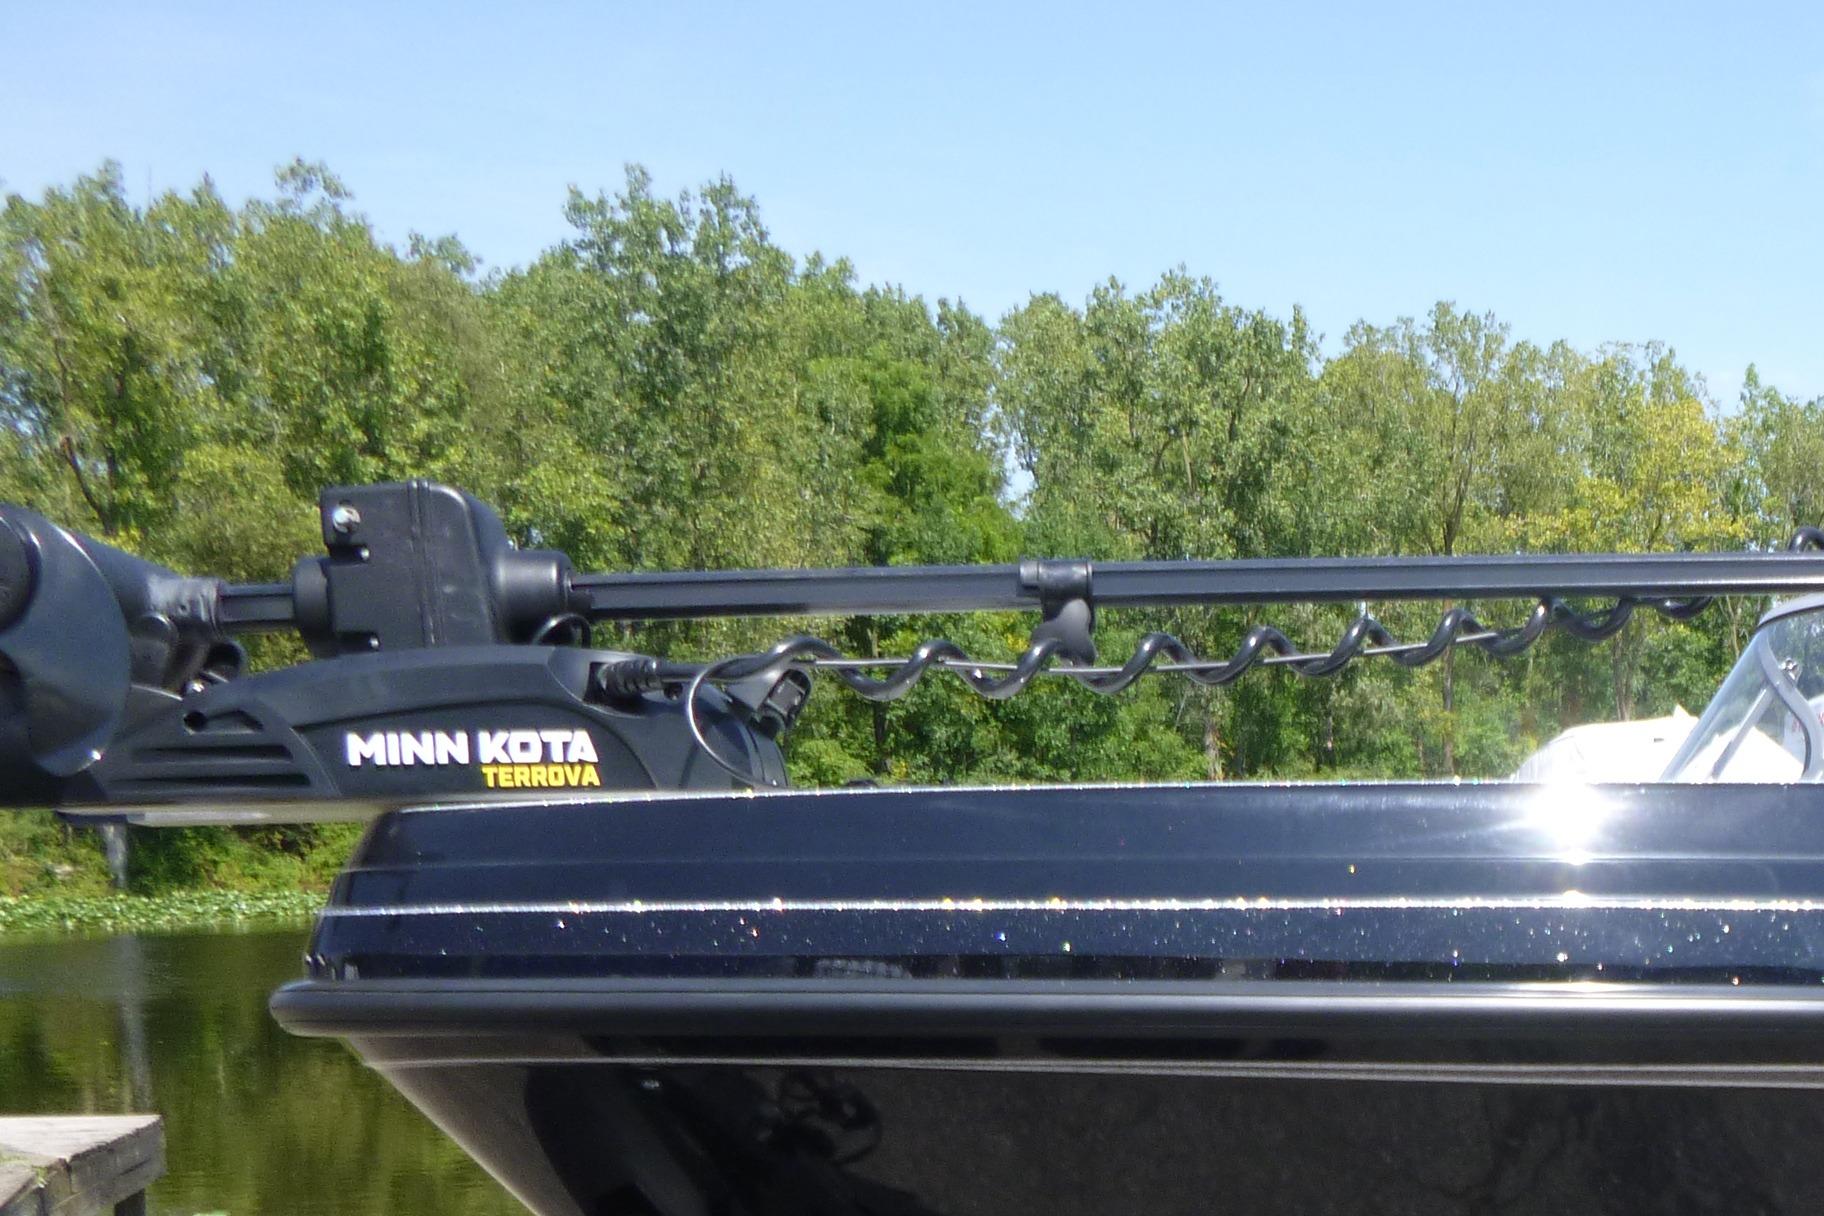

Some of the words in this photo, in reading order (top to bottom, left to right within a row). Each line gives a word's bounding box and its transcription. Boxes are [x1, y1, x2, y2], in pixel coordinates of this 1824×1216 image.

[345, 730, 469, 766] MINN
[478, 729, 598, 763] KOTA
[482, 765, 600, 788] TERROVA
